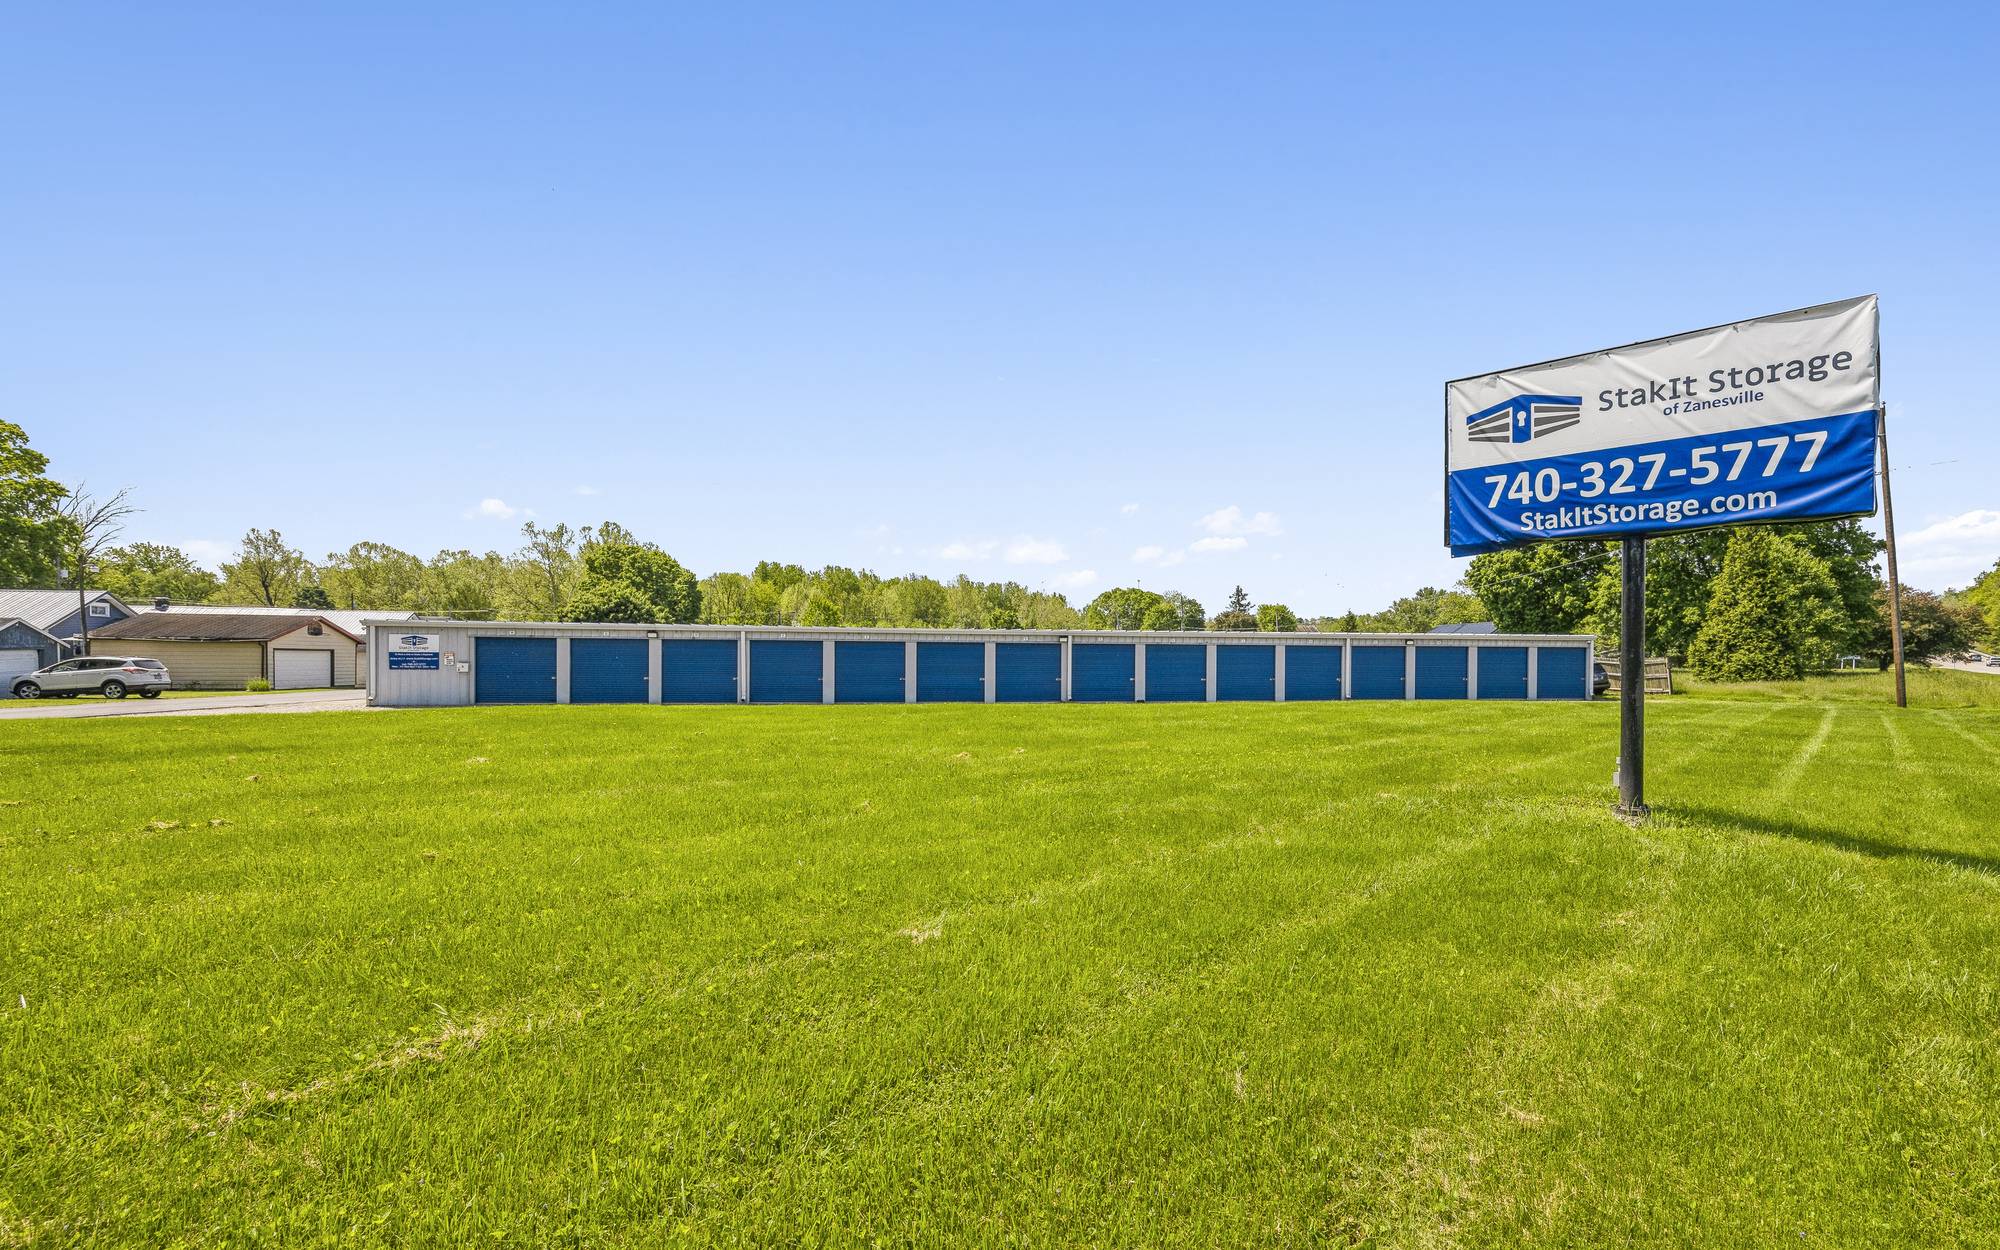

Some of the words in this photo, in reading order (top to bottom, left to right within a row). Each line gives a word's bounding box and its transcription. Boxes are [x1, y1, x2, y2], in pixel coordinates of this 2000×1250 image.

[1598, 375, 1698, 412] StakIt
[1708, 349, 1853, 393] Storage
[1662, 402, 1680, 416] of
[1683, 389, 1764, 413] Zanesville
[1484, 430, 1828, 509] 740-327-5777
[1519, 489, 1778, 532] StakItStorage.com
